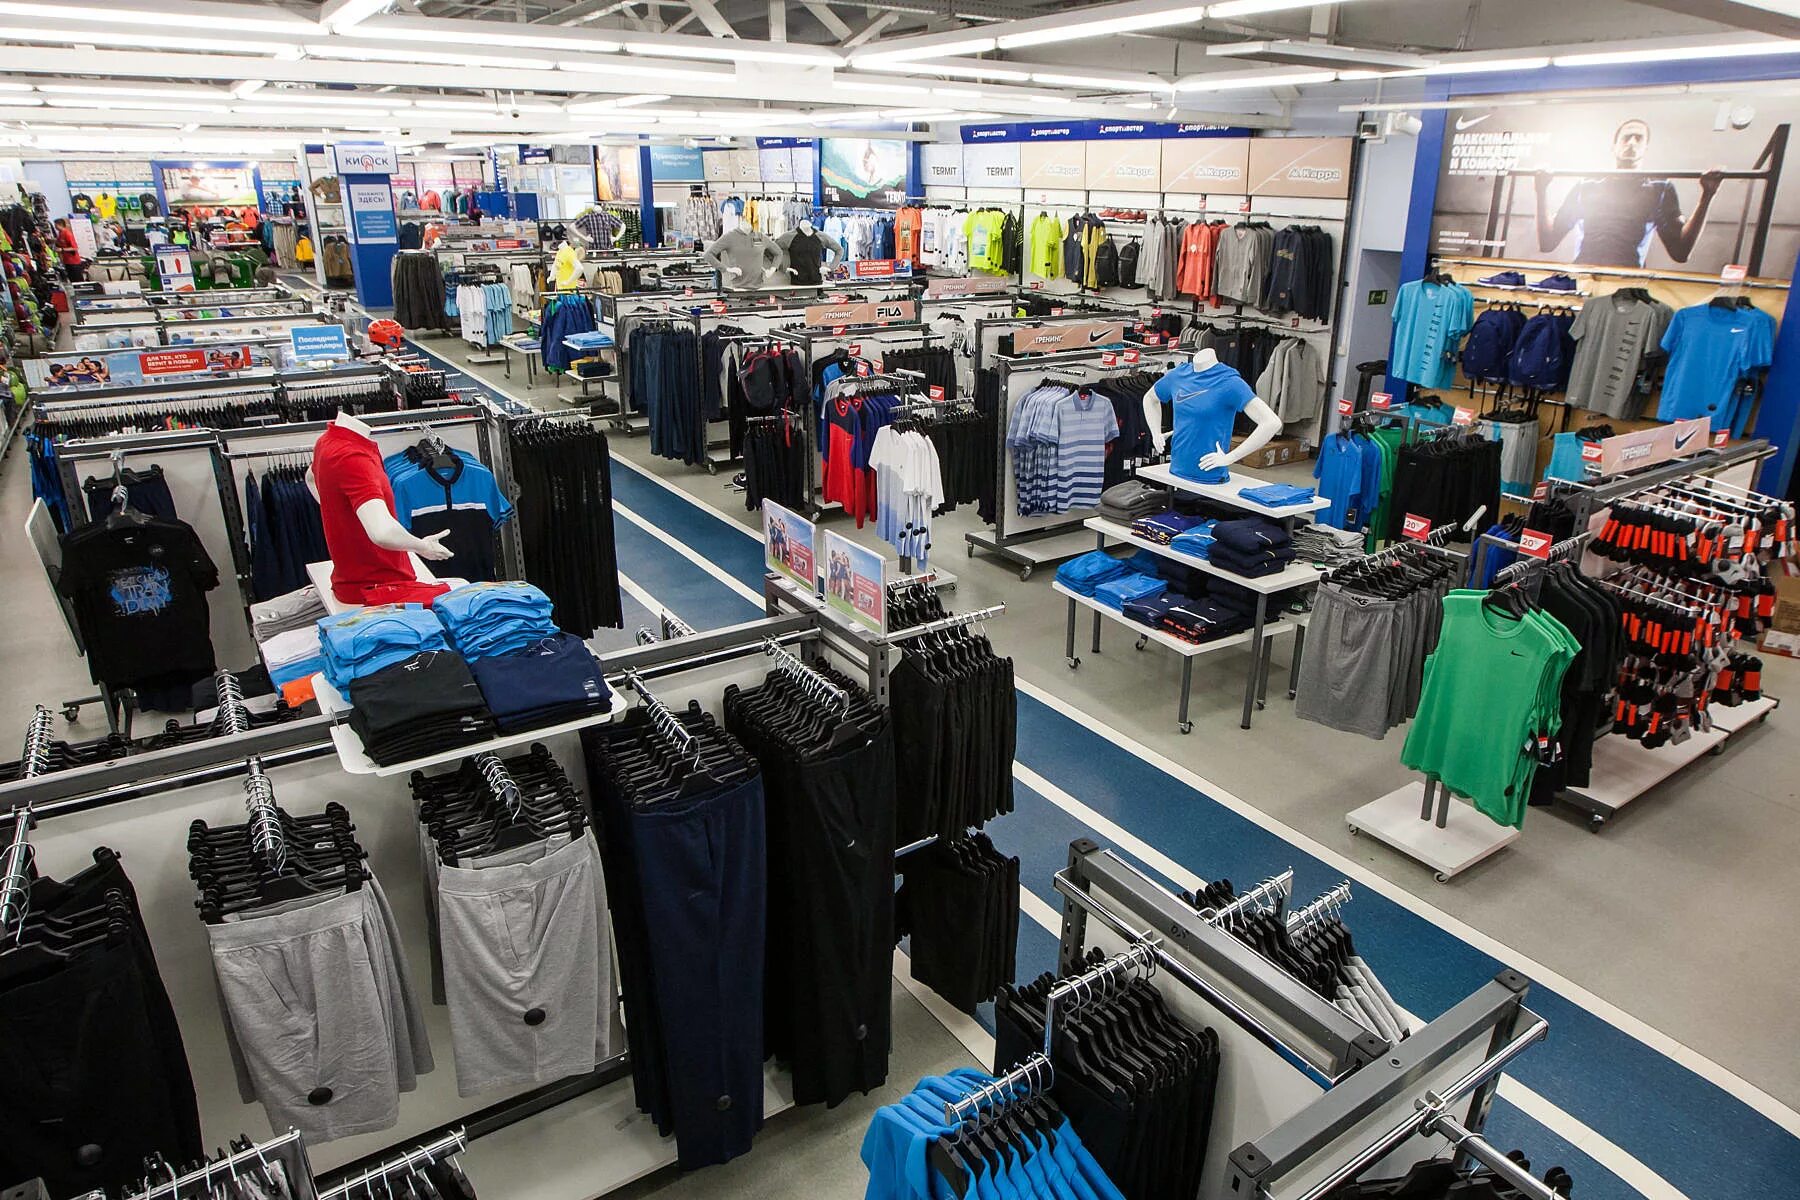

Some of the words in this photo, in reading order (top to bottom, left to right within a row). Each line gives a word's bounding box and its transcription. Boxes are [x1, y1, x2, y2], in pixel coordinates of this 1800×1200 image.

[932, 166, 957, 176] TERMIT
[986, 167, 1014, 176] TERMIT
[1207, 167, 1239, 178] Kappa
[1303, 168, 1340, 180] Kappa
[825, 311, 852, 319] ТРЕНИНГ
[877, 308, 901, 318] FILA
[1035, 335, 1063, 344] ТРЕНИНГ
